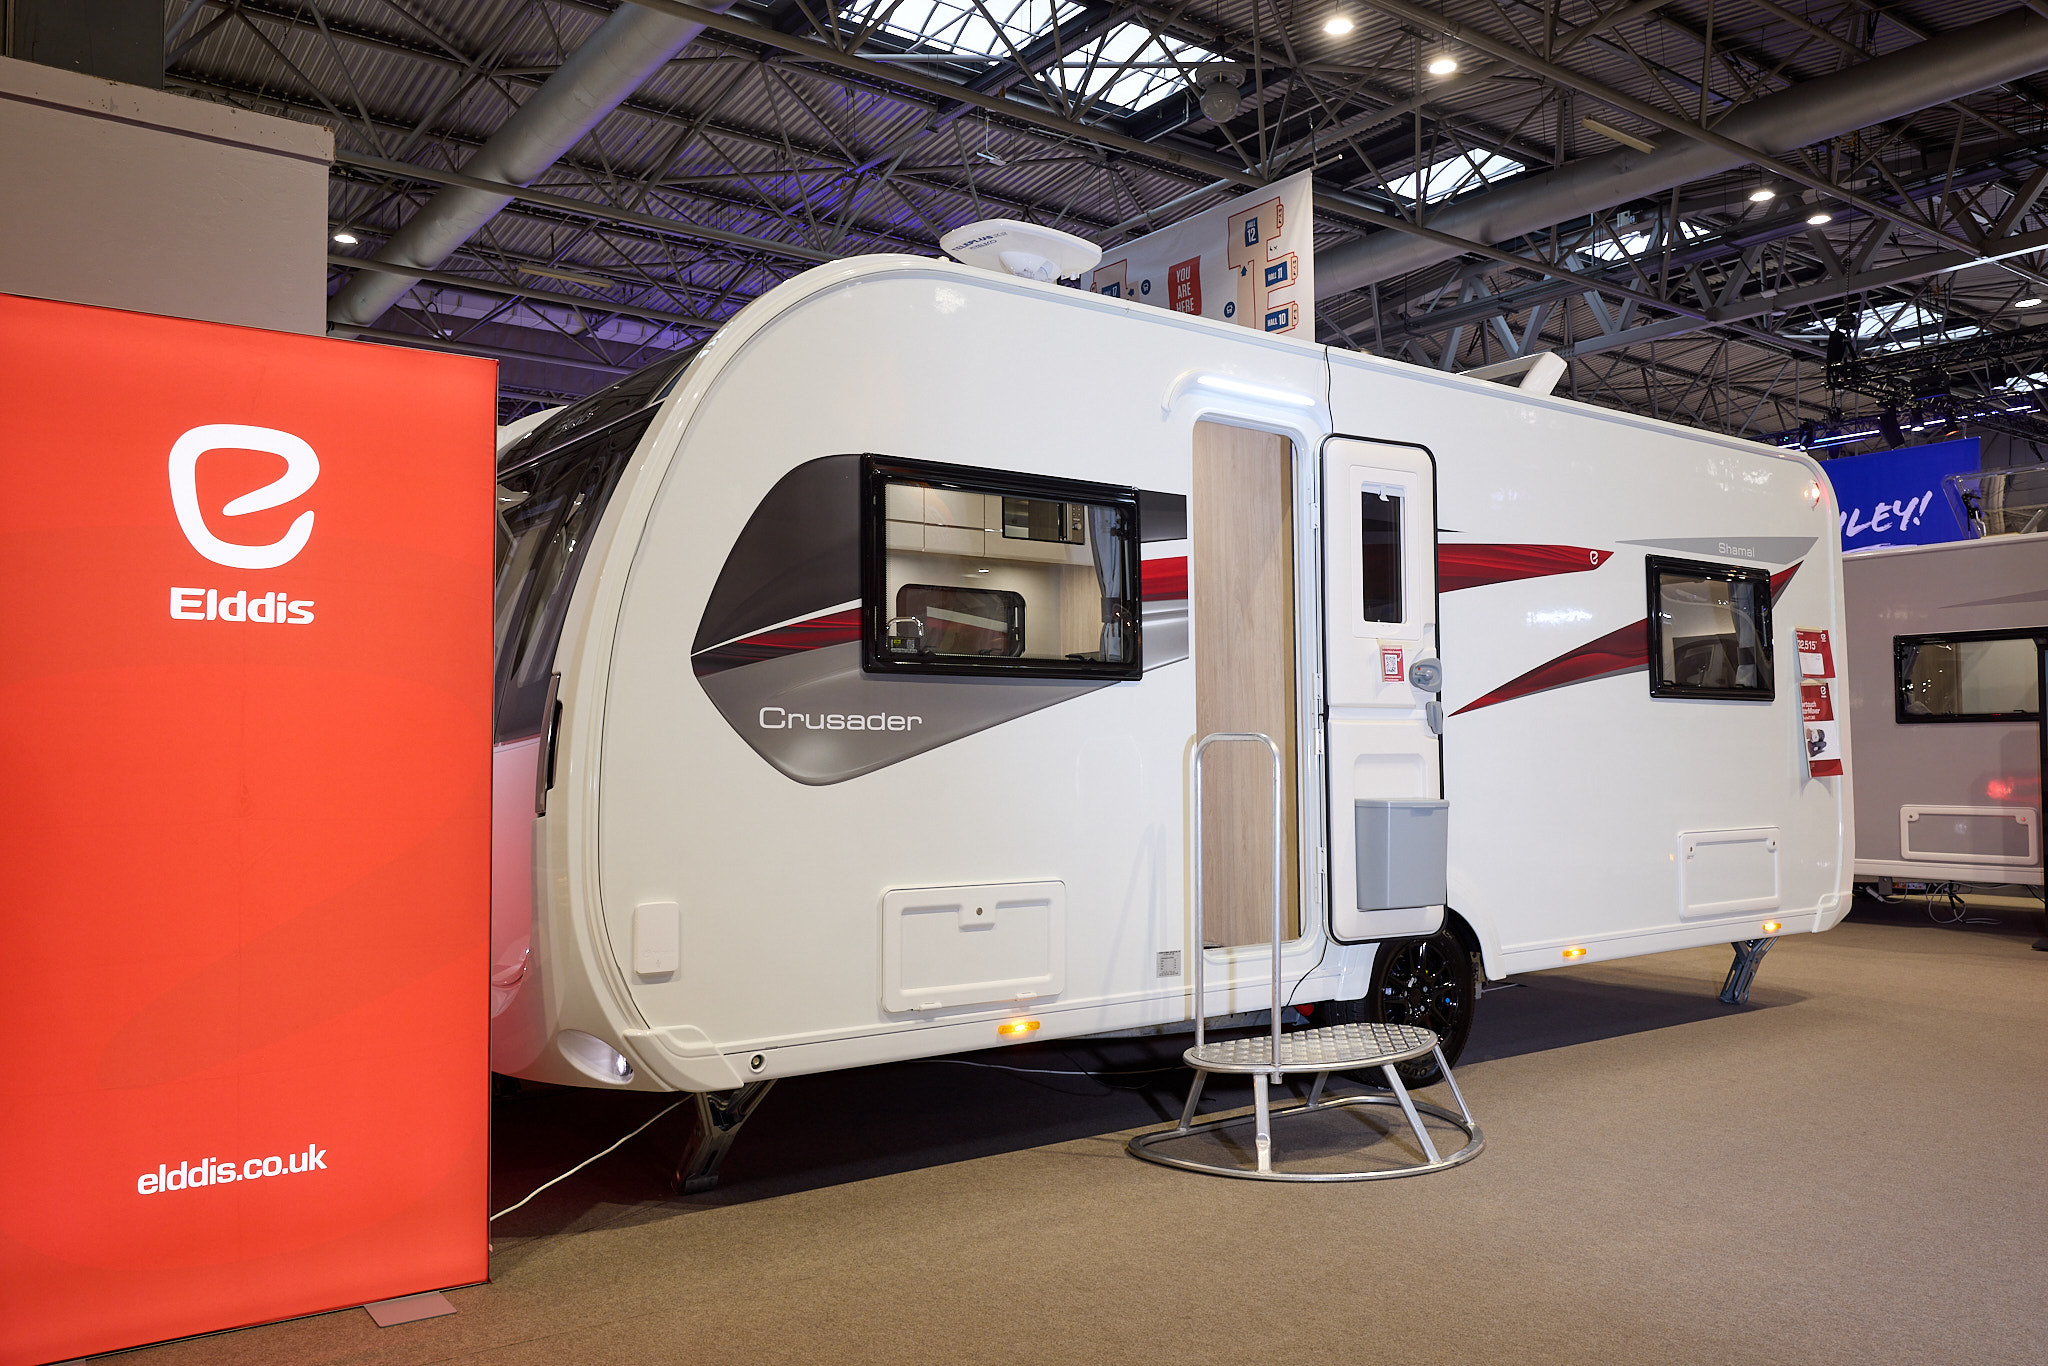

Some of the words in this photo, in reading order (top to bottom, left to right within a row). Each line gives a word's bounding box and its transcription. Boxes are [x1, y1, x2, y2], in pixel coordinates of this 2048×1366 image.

[1247, 227, 1257, 243] 12
[1176, 266, 1191, 283] YOU
[1267, 271, 1277, 281] HALL
[1277, 266, 1283, 279] 11
[1177, 282, 1192, 299] ARE
[1176, 298, 1195, 313] HERE
[1267, 318, 1278, 327] HALL
[1278, 312, 1286, 326] 10
[1718, 542, 1756, 558] Shamal
[169, 586, 315, 625] Elddis
[759, 706, 923, 731] Crusader
[137, 1144, 328, 1195] elddis.co.uk
